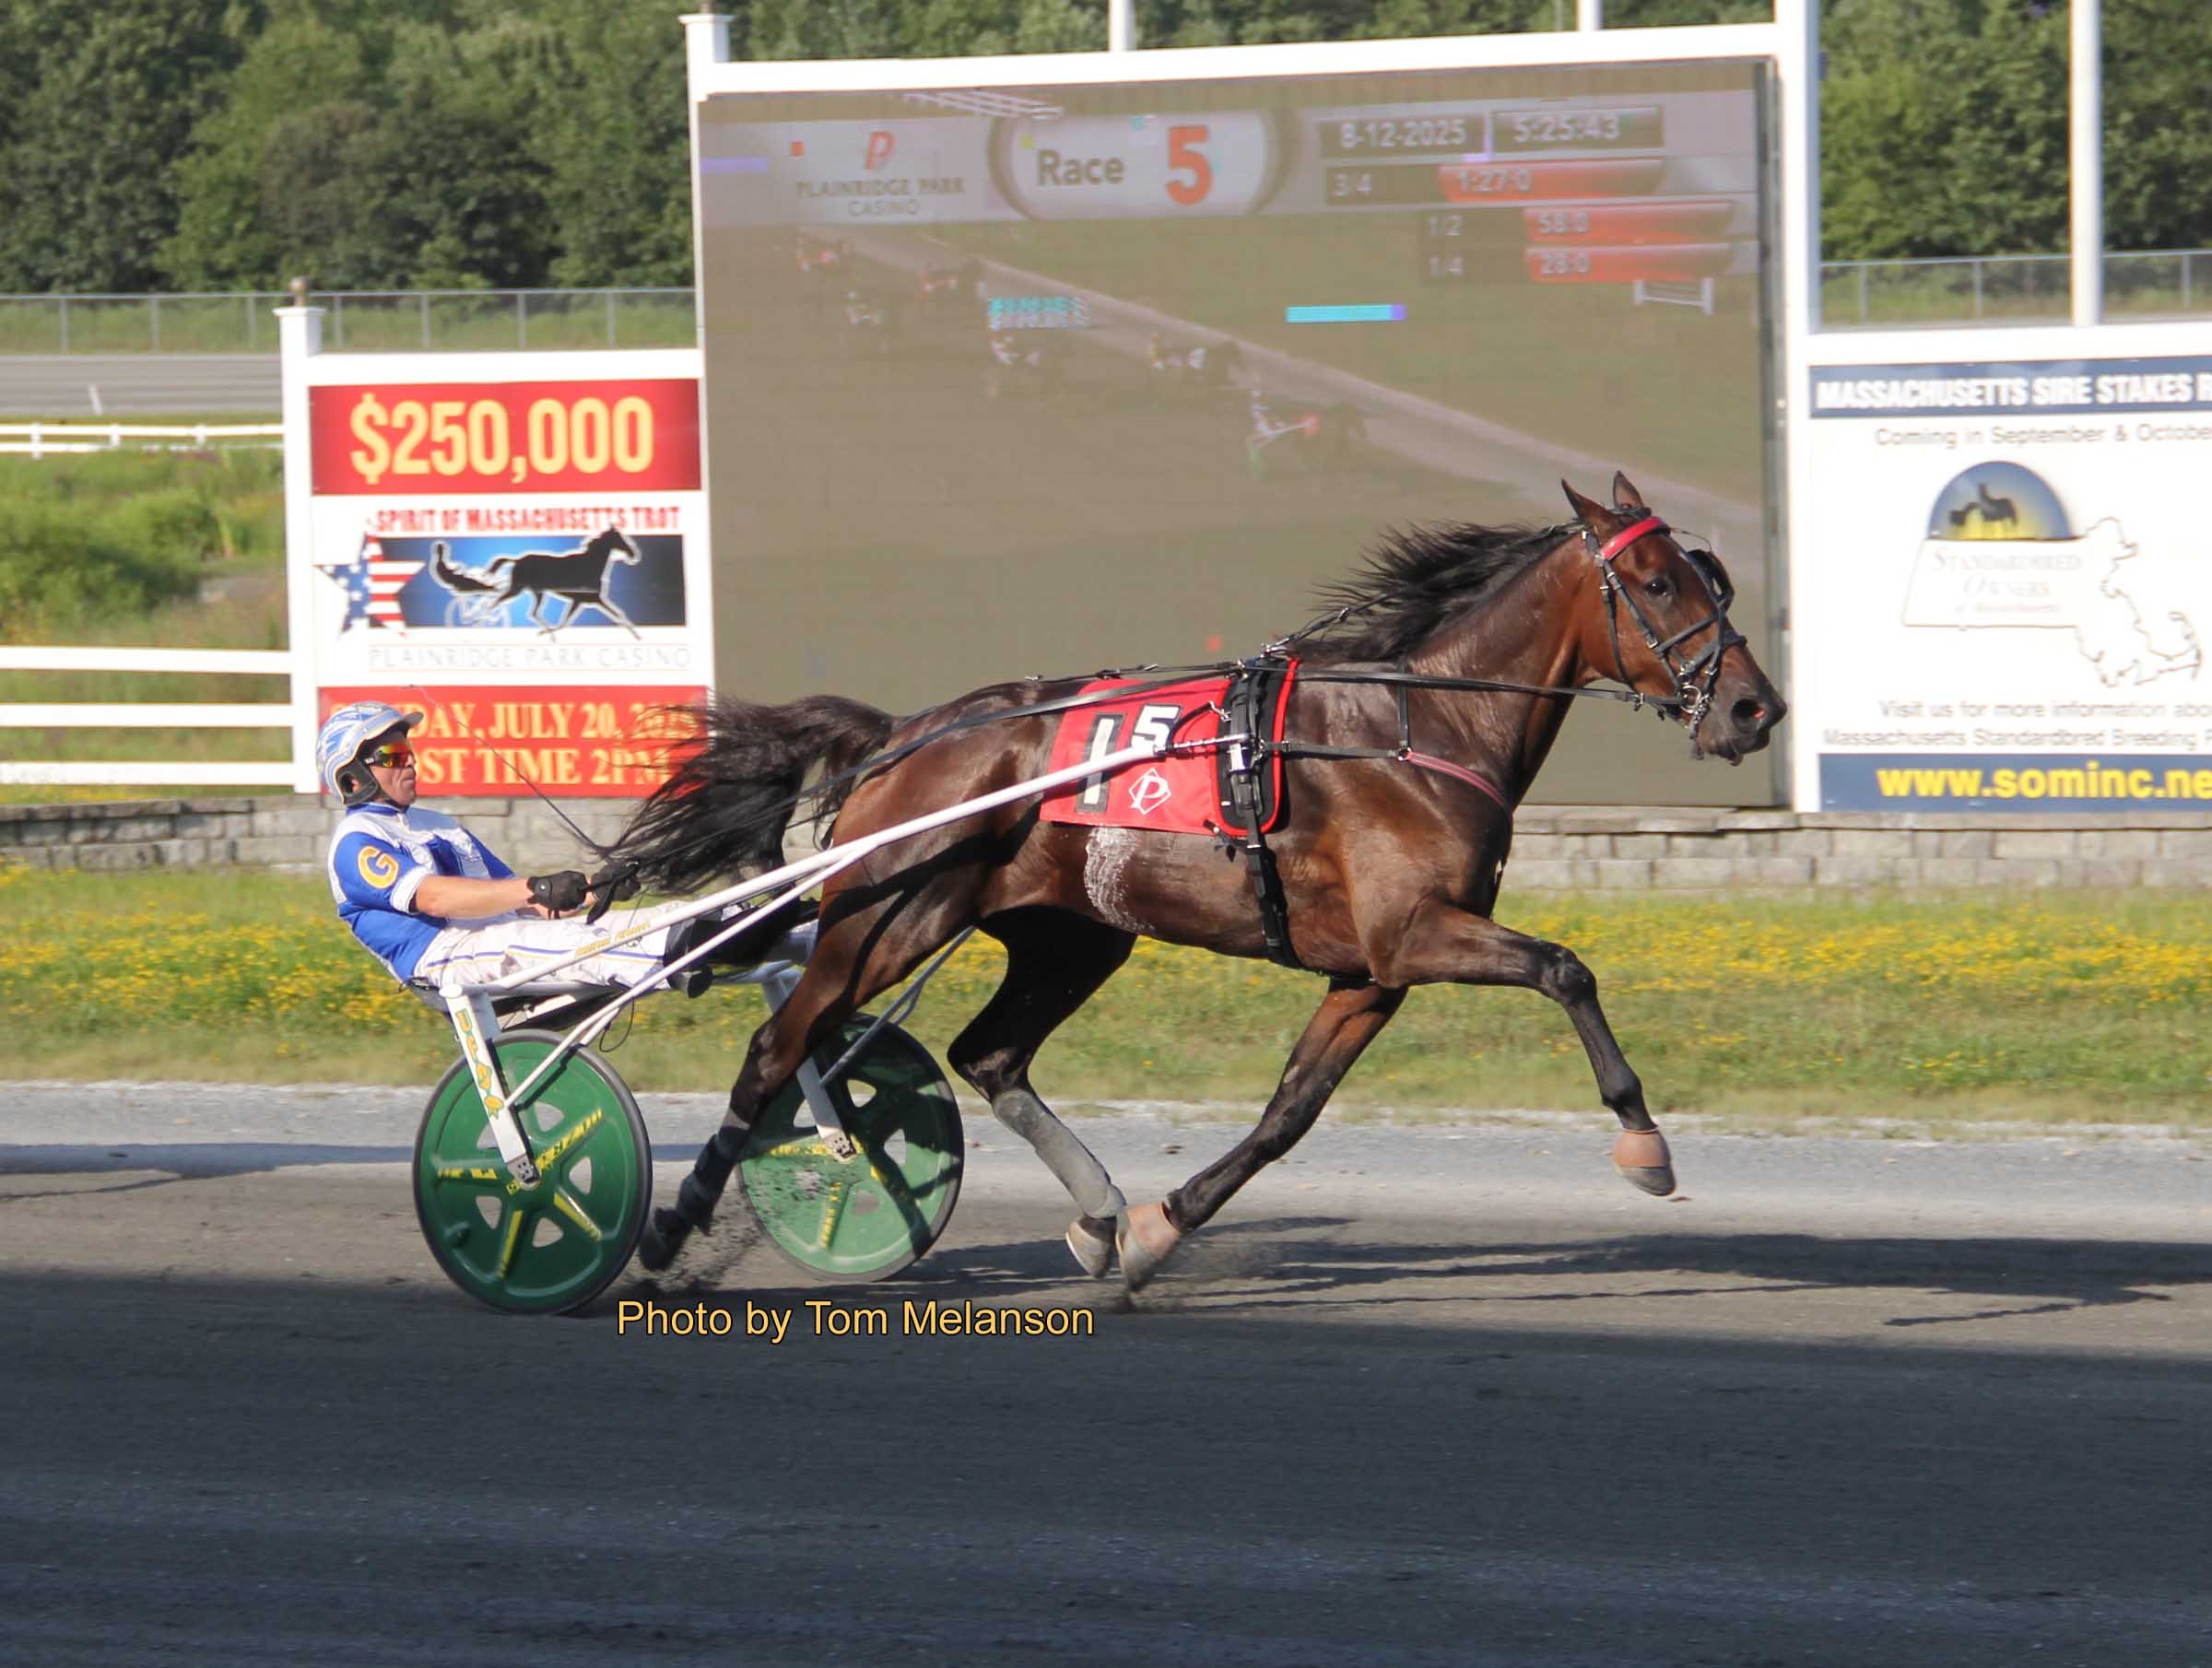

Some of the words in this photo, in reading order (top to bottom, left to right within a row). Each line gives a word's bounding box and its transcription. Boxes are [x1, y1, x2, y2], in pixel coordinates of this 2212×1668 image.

[1341, 119, 1467, 147] 8-12-2025
[1512, 113, 1619, 143] 5:25:43
[1036, 148, 1125, 185] Race
[1164, 124, 1213, 206] 5
[848, 199, 920, 217] CASINO
[1817, 377, 2029, 409] MASSACHUSETTS
[2032, 377, 2093, 405] SIRE
[2097, 374, 2192, 405] STAKES
[350, 393, 653, 484] $250,000
[1875, 428, 1958, 449] Coming
[1964, 429, 1985, 444] in
[1991, 425, 2106, 448] September
[2114, 425, 2127, 442] &
[376, 509, 436, 533] SPIRIT
[441, 509, 460, 531] OF
[466, 508, 627, 532] MASSACHUSETTS
[631, 506, 680, 530] TROT
[368, 648, 514, 667] PLAINRIDGE
[524, 648, 587, 666] PARK
[597, 647, 692, 667] CASINO
[488, 703, 575, 739] JULY
[1878, 699, 1924, 717] Visit
[1929, 703, 1954, 717] us
[1959, 700, 1988, 717] for
[1994, 703, 2045, 718] more
[2052, 699, 2167, 718] information
[1823, 728, 1966, 746] Massachusetts
[1972, 727, 2106, 746] Standardbred
[2112, 728, 2197, 752] Breeding
[477, 747, 583, 784] TIME
[590, 747, 674, 785] 2PM
[1876, 761, 2212, 798] www.sominc.ne
[358, 845, 400, 890] G
